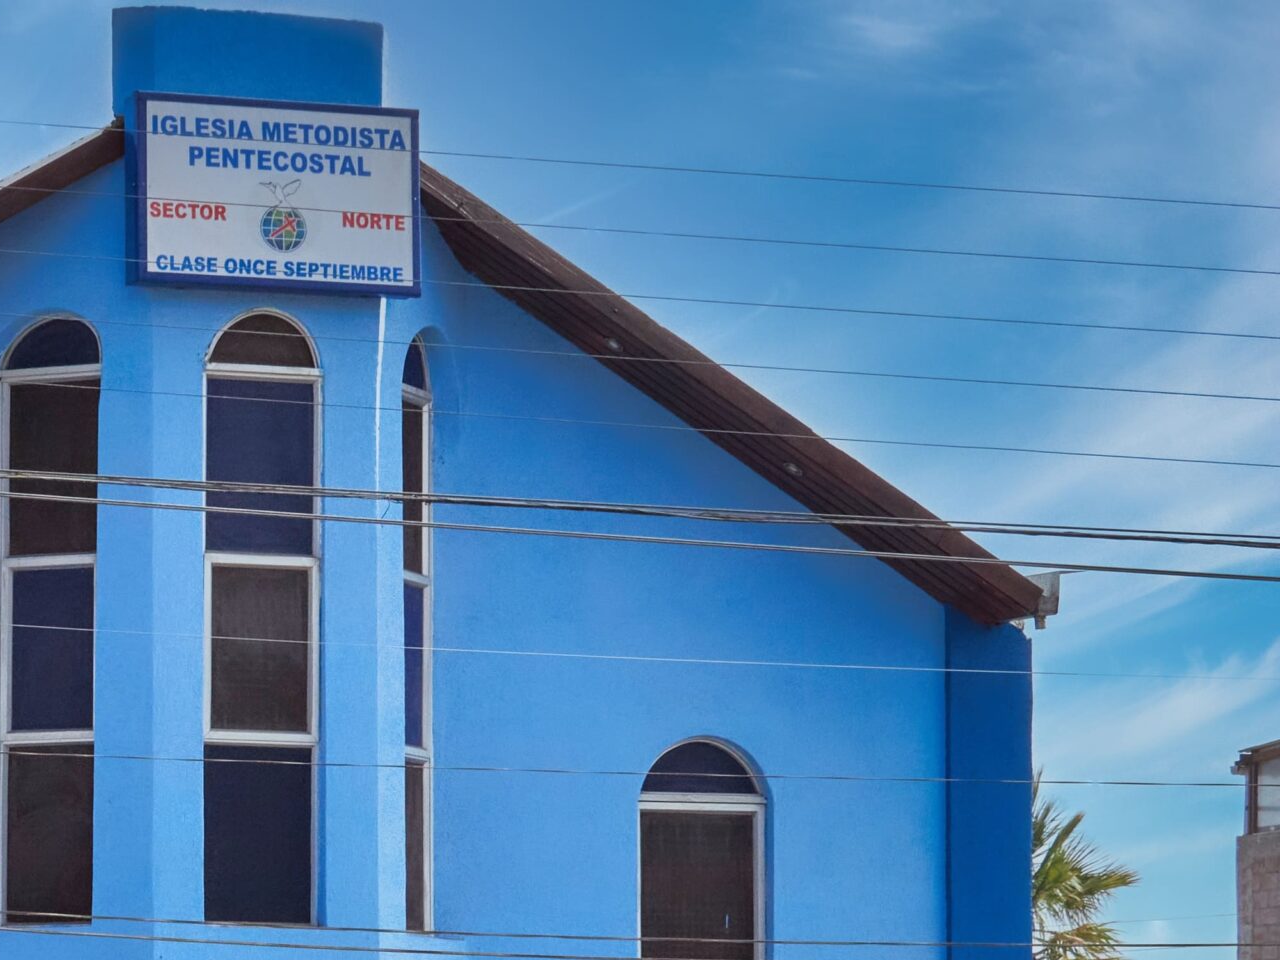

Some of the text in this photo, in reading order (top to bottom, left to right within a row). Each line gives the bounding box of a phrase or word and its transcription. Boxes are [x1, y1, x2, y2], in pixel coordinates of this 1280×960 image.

[151, 115, 406, 150] IGLESIA METODISTA
[188, 145, 372, 176] PENTECOSTAL
[150, 202, 405, 230] SECTOR NORTE
[156, 254, 404, 282] CLASE ONCE SEPTIEMBRE
